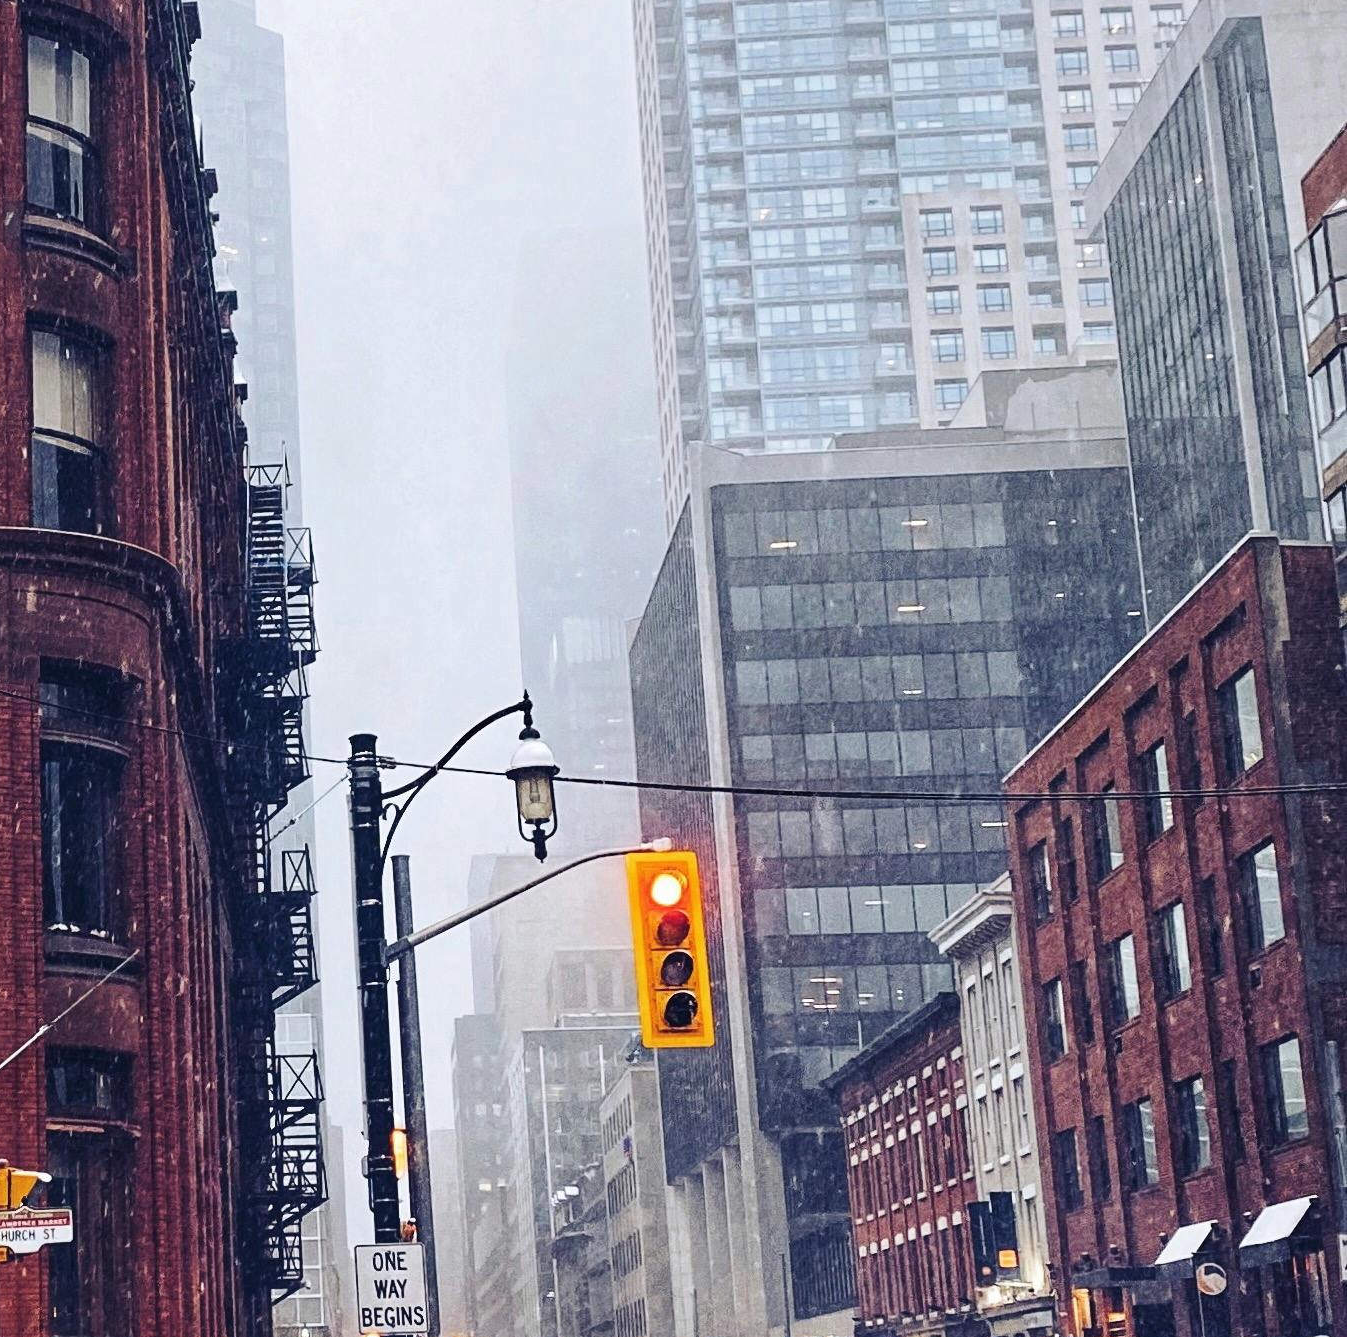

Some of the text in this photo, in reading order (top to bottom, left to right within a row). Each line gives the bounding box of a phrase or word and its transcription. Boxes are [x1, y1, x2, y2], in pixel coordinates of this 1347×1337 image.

[43, 1228, 56, 1241] ST
[372, 1250, 407, 1271] ONE
[374, 1279, 407, 1299] WAY
[361, 1306, 424, 1328] BEGINS
